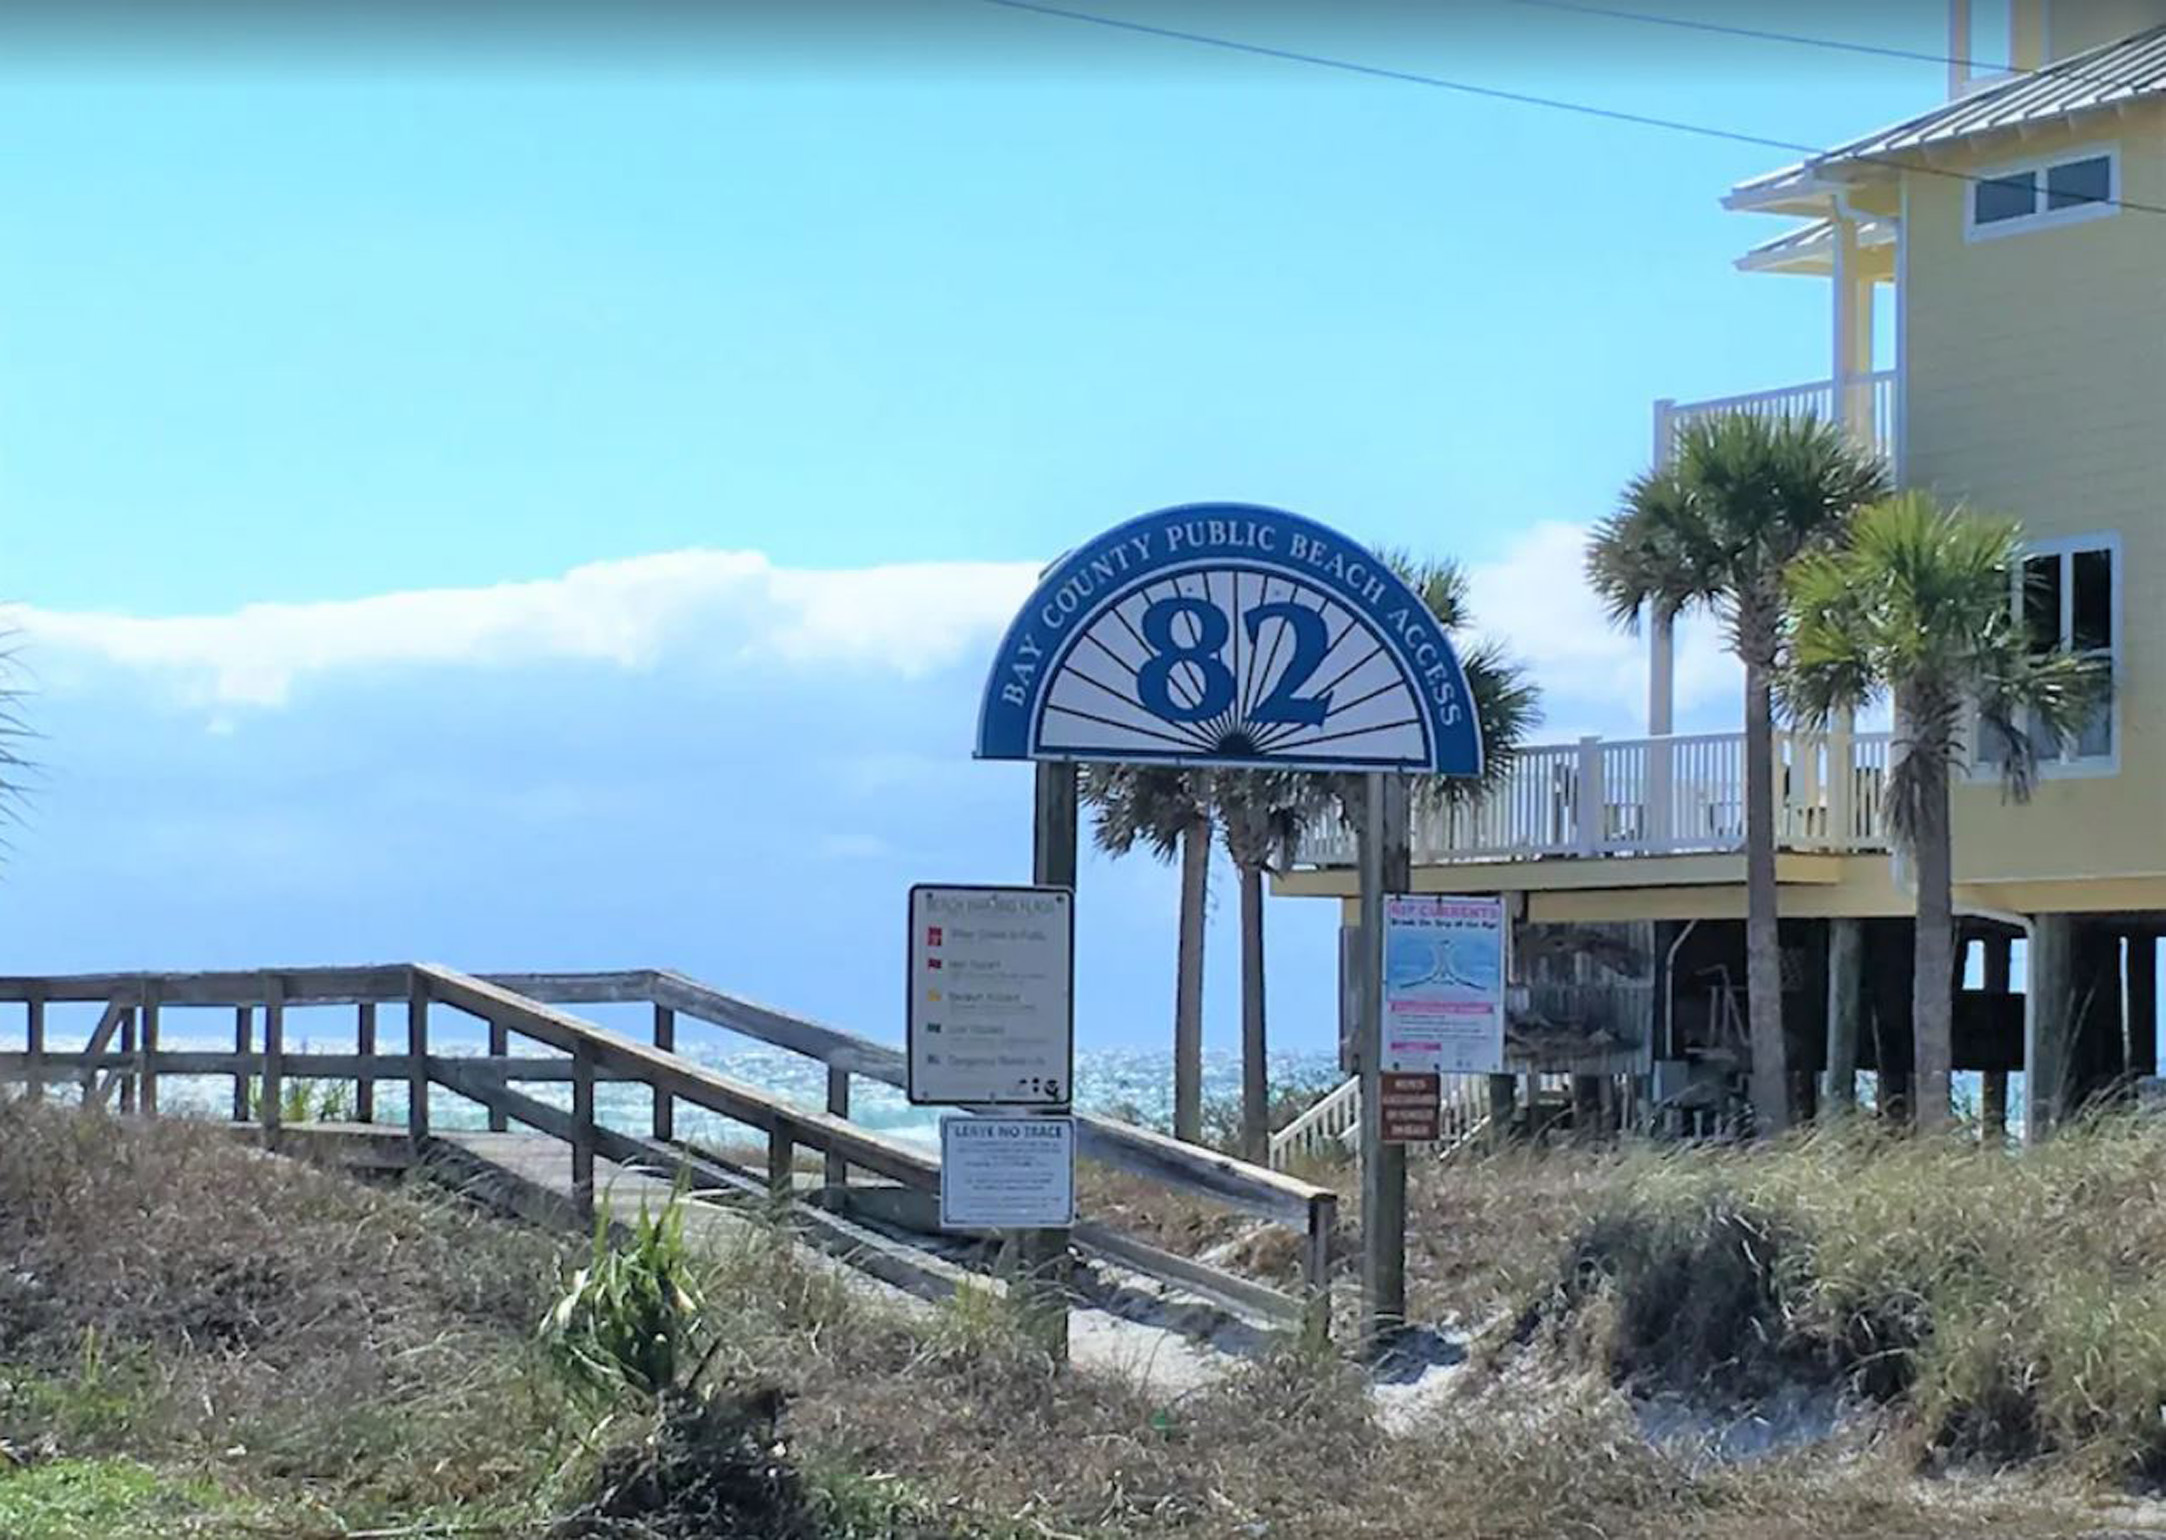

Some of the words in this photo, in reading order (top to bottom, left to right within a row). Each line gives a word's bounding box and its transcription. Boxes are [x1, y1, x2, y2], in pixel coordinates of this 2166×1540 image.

[1002, 633, 1042, 706] BAY
[1042, 533, 1151, 628] COUNTY
[1166, 521, 1276, 551] PUBLIC
[1290, 533, 1386, 604] BEACH
[1388, 608, 1461, 726] ACCESS
[1137, 598, 1334, 727] 82
[955, 1125, 994, 1138] LEAVE
[998, 1125, 1020, 1138] NO
[1024, 1125, 1062, 1139] TRACE
